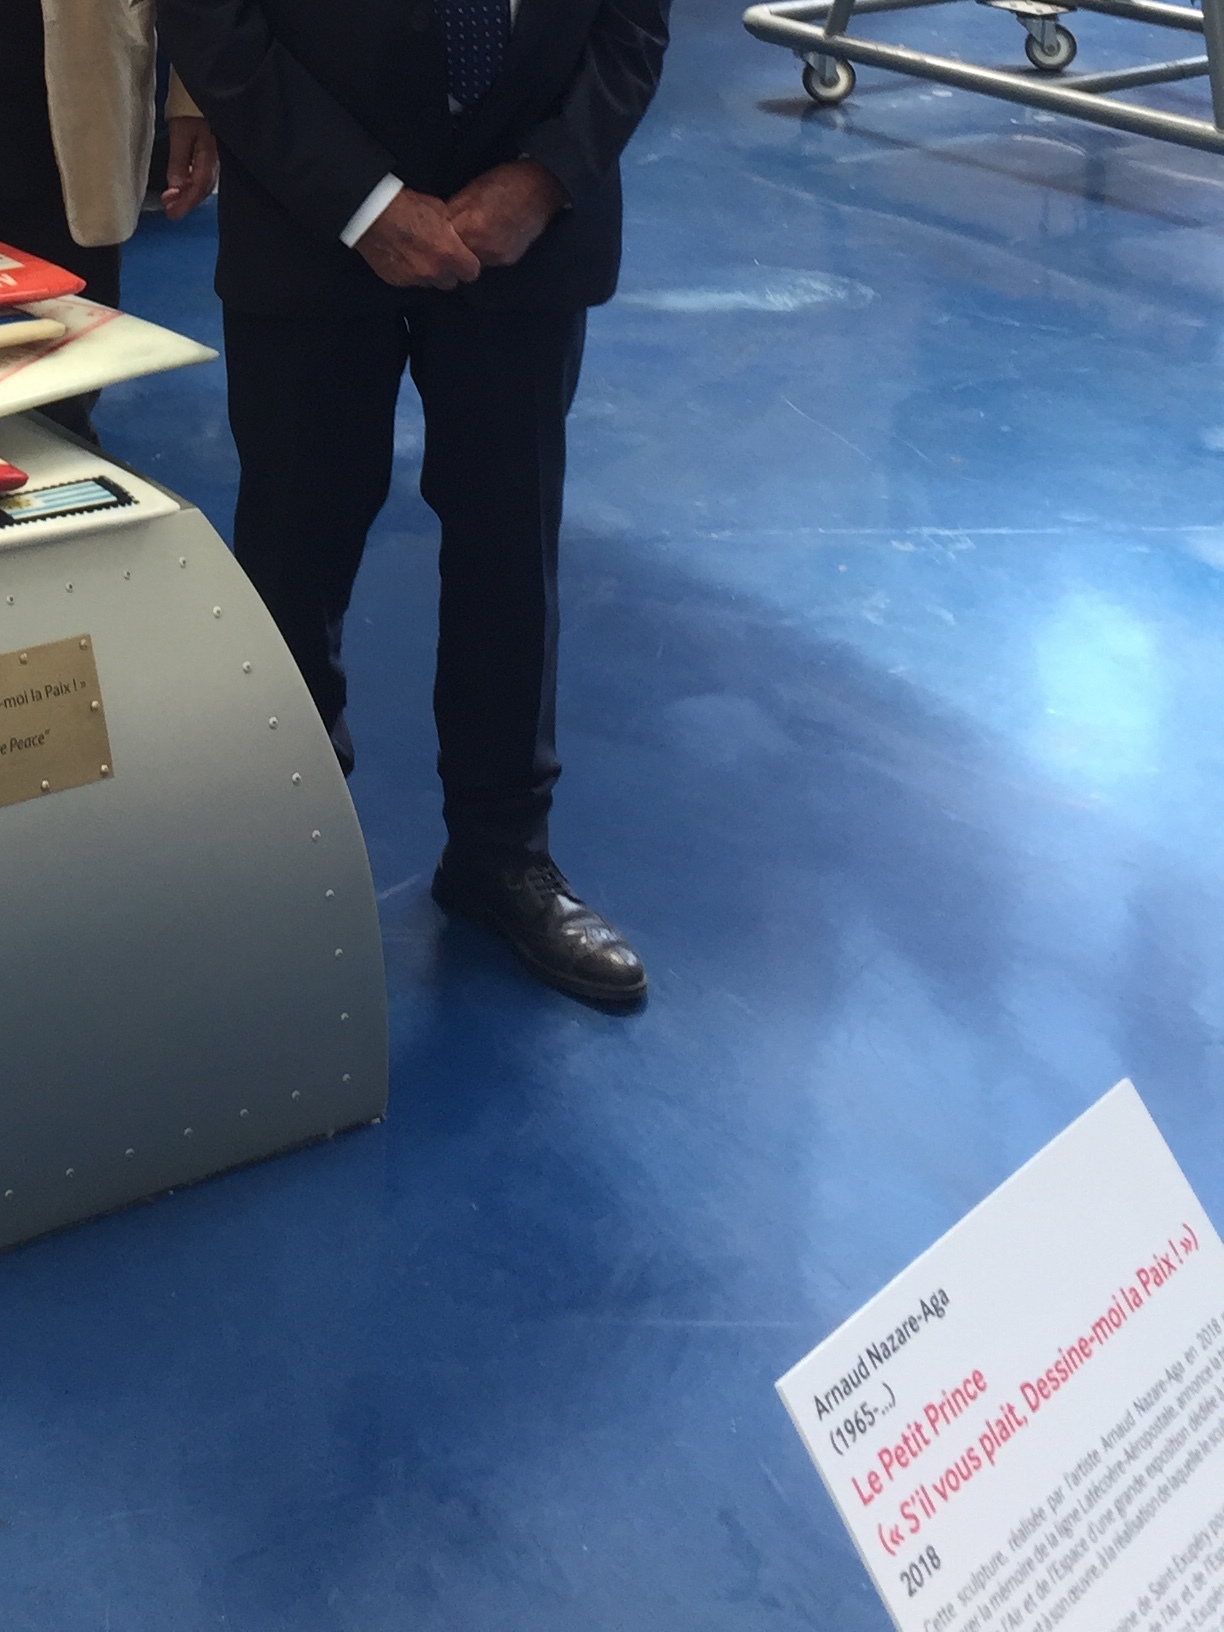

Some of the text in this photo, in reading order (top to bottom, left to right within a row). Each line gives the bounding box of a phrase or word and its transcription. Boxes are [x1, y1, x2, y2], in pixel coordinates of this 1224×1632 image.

[31, 687, 42, 702] la
[45, 681, 71, 698] Paix
[813, 1286, 951, 1421] Arnaud Nazare-Aga
[899, 1484, 937, 1535] S'il
[932, 1446, 983, 1502] vous
[979, 1402, 1028, 1466] plait,
[1020, 1294, 1127, 1413] Dessine-moi
[1120, 1286, 1143, 1313] la
[1136, 1253, 1177, 1297] Paix
[1168, 1239, 1183, 1264] !
[851, 1368, 987, 1507] Le Petit Prince
[976, 1598, 993, 1623] la
[1030, 1536, 1050, 1565] de
[1043, 1525, 1059, 1551] la
[1053, 1502, 1084, 1545] ligne
[1173, 1361, 1215, 1412] annonce
[1004, 1500, 1048, 1553] réalisée
[1045, 1483, 1068, 1515] par
[1063, 1443, 1102, 1493] l'artiste
[1098, 1407, 1136, 1455] Arnaud
[1132, 1354, 1188, 1422] Nazare-Aga
[1182, 1343, 1200, 1367] en
[1195, 1315, 1223, 1352] 2018
[900, 1544, 942, 1598] 2018
[1020, 1589, 1037, 1615] et
[1031, 1572, 1052, 1602] de
[1111, 1468, 1150, 1520] grande
[1142, 1420, 1193, 1483] exposition
[1048, 1592, 1071, 1625] son
